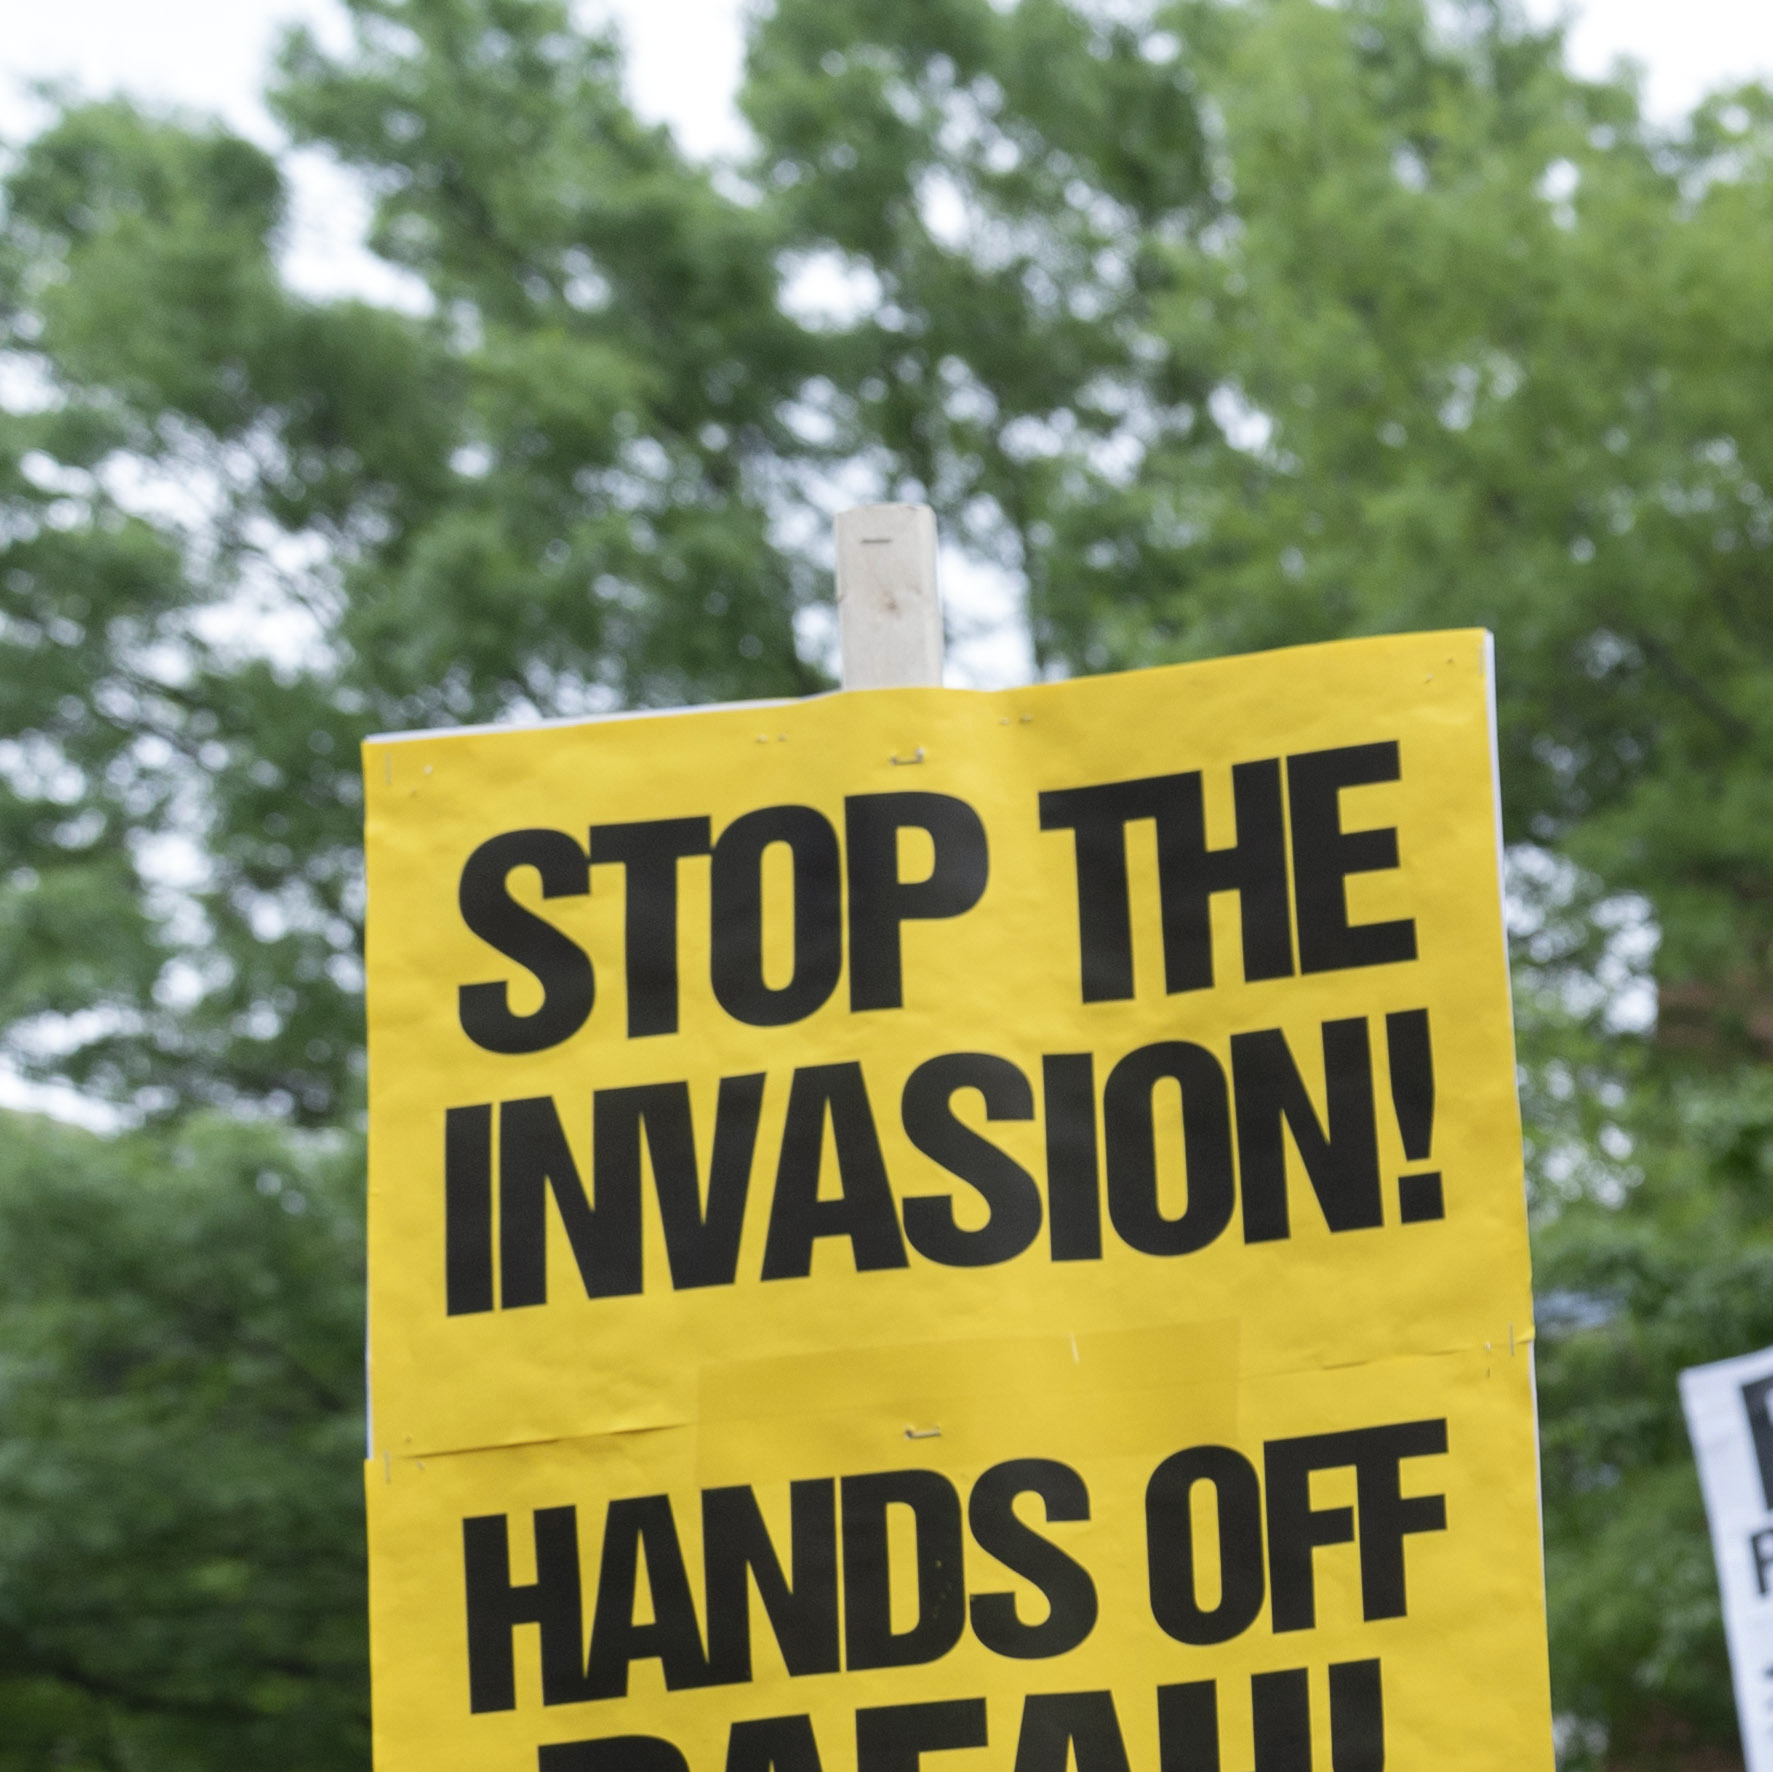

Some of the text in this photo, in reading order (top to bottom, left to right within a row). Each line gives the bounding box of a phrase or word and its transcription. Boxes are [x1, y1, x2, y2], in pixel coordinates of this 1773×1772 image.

[457, 739, 1419, 1055] STOP THE
[445, 1007, 1446, 1318] INVASION!
[462, 1417, 1449, 1715] HANDS OFF
